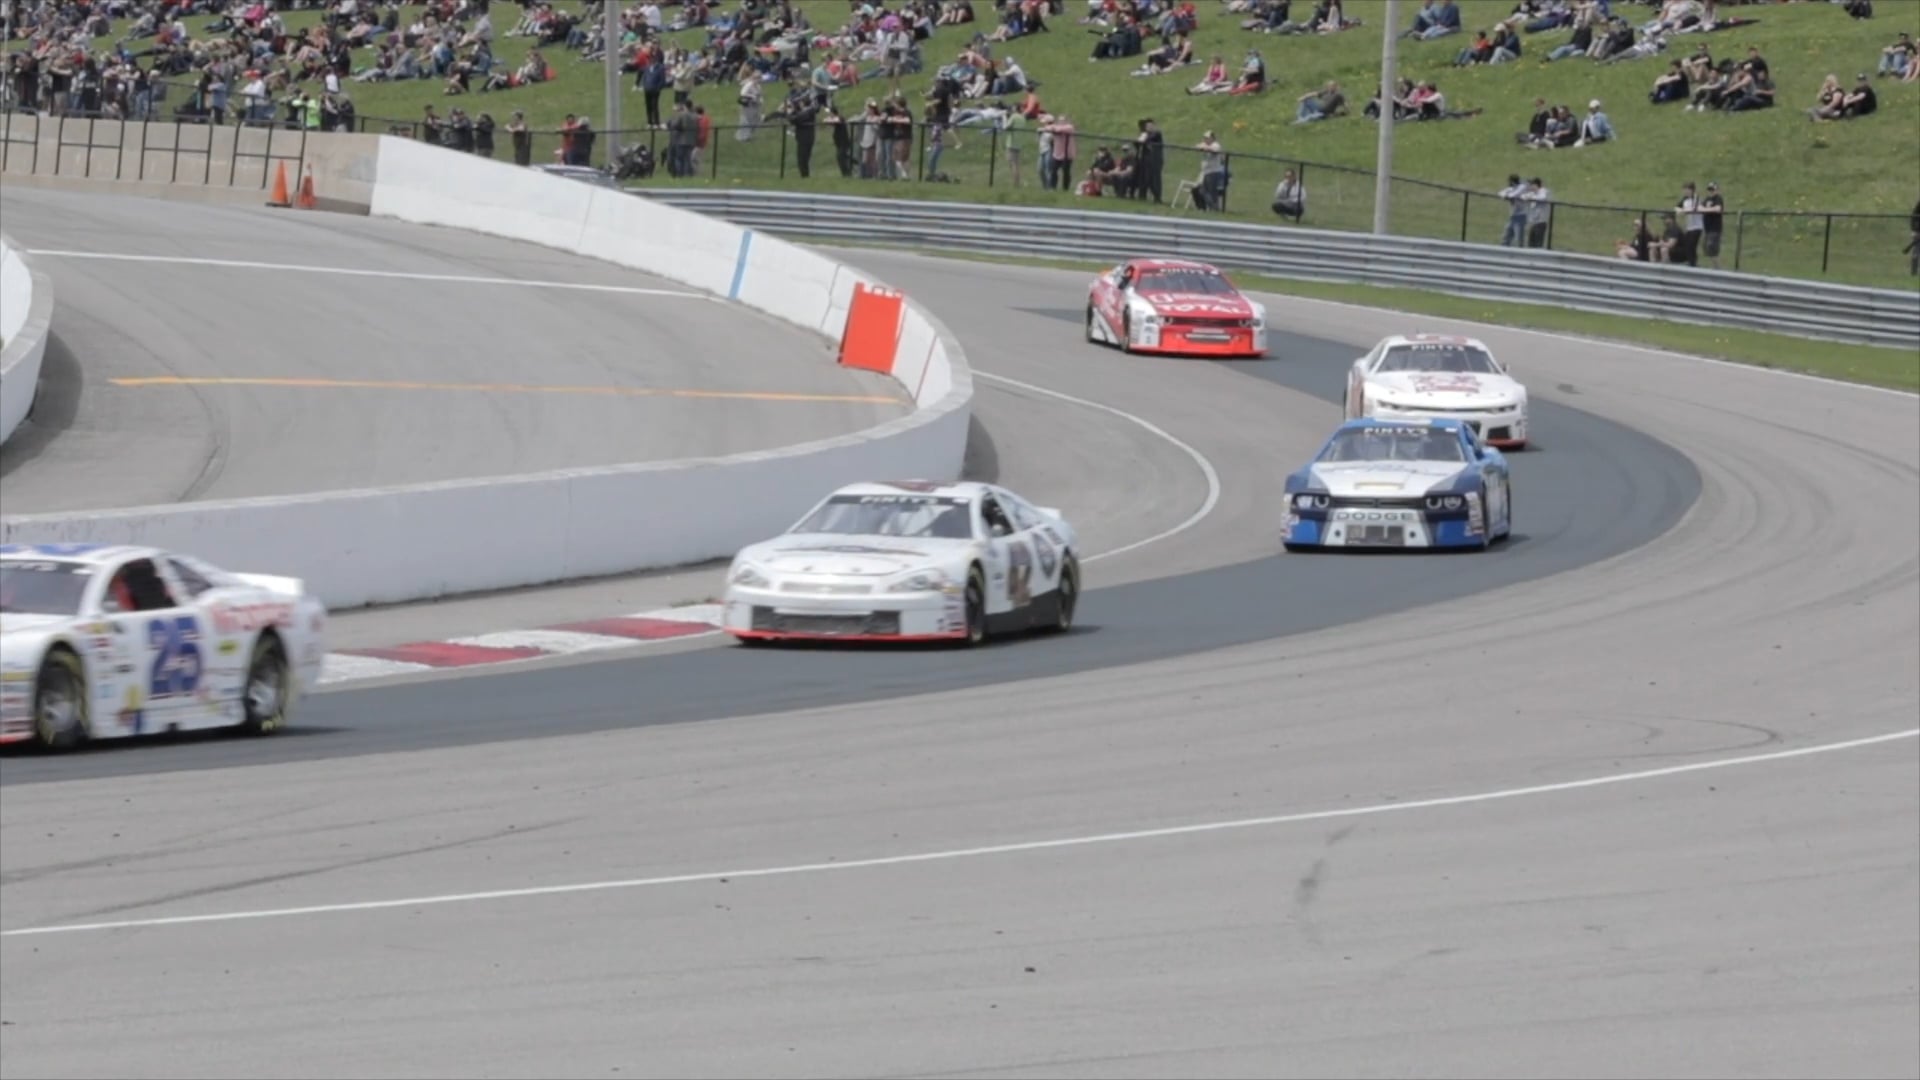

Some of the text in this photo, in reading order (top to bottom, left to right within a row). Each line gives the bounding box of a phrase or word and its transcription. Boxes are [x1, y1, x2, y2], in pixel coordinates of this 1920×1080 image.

[1154, 303, 1251, 315] TOTAL
[1364, 427, 1429, 435] PINTY'S
[859, 495, 938, 504] PINTY'S
[1336, 511, 1415, 521] DODGE
[147, 614, 205, 699] 25
